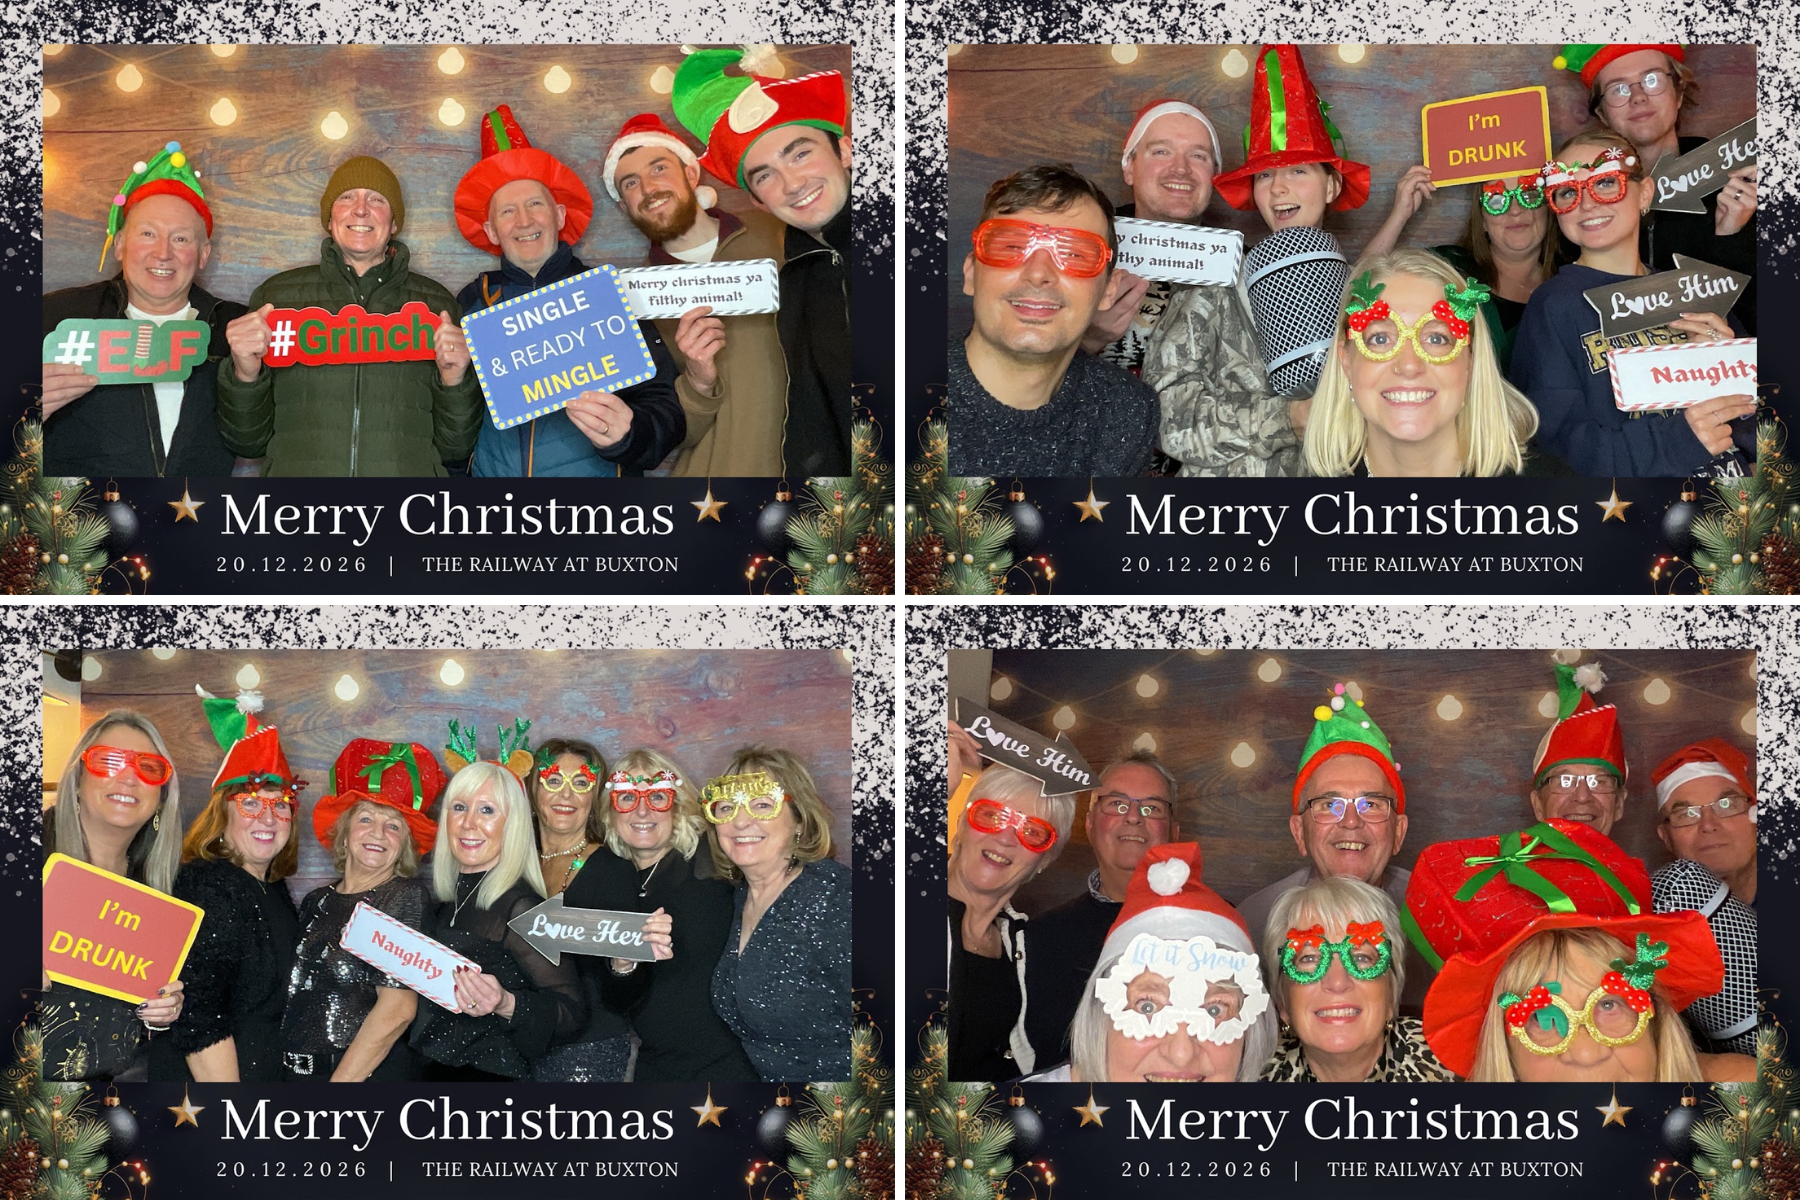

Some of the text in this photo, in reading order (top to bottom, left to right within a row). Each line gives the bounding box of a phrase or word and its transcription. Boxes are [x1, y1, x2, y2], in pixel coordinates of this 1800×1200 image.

[1448, 140, 1527, 167] DRUNK
[1717, 137, 1757, 170] He
[1131, 232, 1206, 251] christmas
[1209, 243, 1228, 255] ya
[1149, 256, 1205, 271] animal!
[628, 273, 763, 291] Merry christmas ya
[691, 290, 743, 304] animal!
[1677, 273, 1739, 303] Him
[502, 290, 590, 336] SINGLE
[270, 313, 435, 357] #Grinch
[491, 315, 626, 377] & READY TO
[521, 354, 620, 404] MINGLE
[1036, 747, 1091, 786] Him
[591, 919, 644, 947] Her
[48, 929, 154, 981] DRUNK
[371, 930, 443, 980] Naughty
[1131, 937, 1249, 972] Let it Snow
